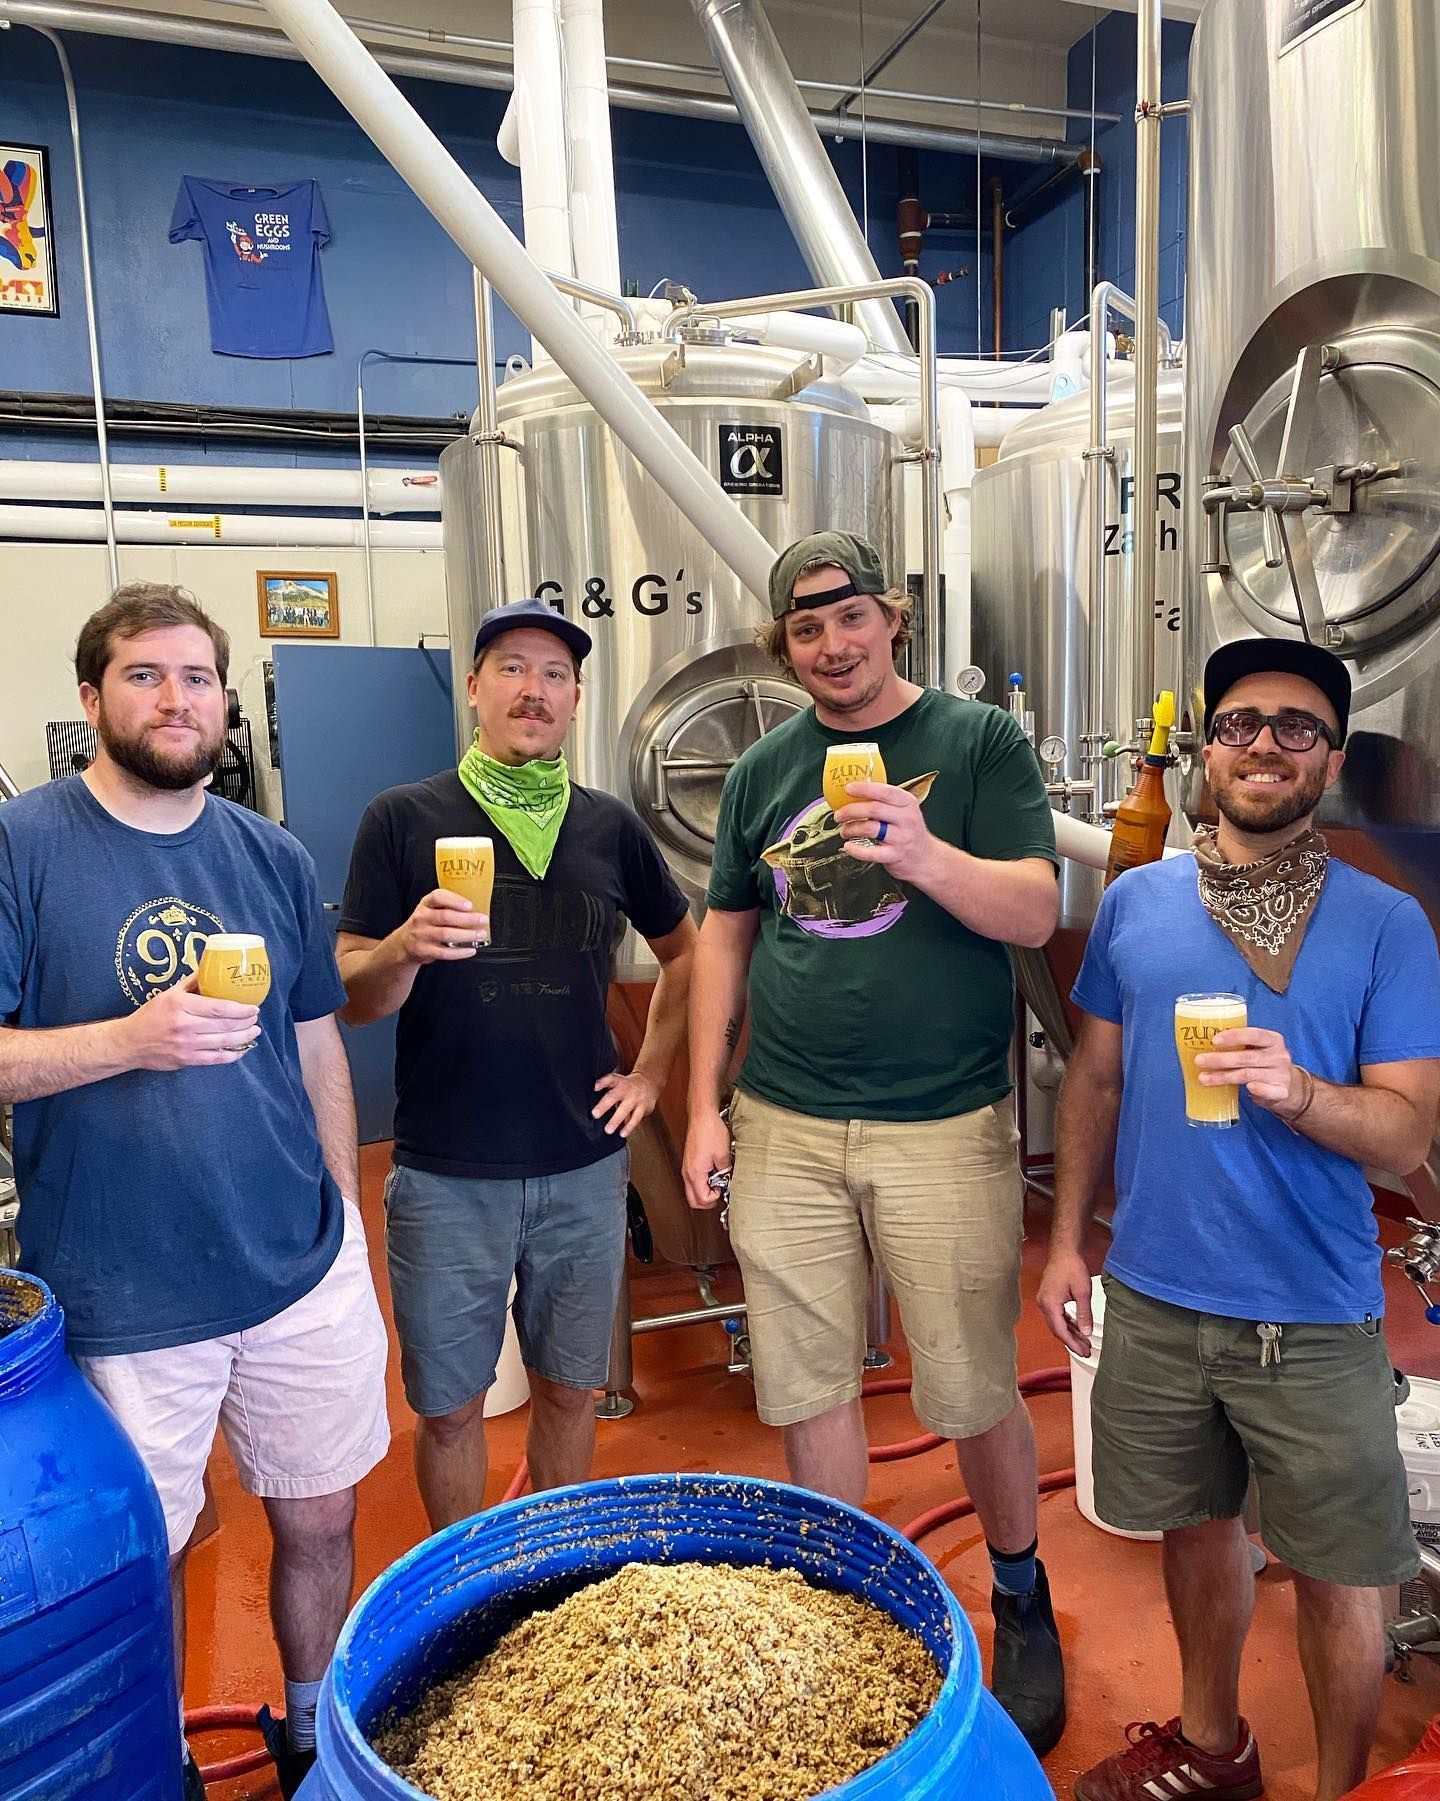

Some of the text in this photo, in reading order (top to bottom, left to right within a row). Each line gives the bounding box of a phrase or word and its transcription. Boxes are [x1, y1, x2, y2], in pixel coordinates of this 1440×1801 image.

[254, 213, 289, 225] GREEN
[255, 224, 290, 238] EGGS
[256, 243, 291, 251] MUSHROOMS
[727, 431, 774, 443] ALPHA
[1104, 519, 1177, 556] Zah
[581, 577, 615, 618] &
[439, 859, 485, 873] ZUNI
